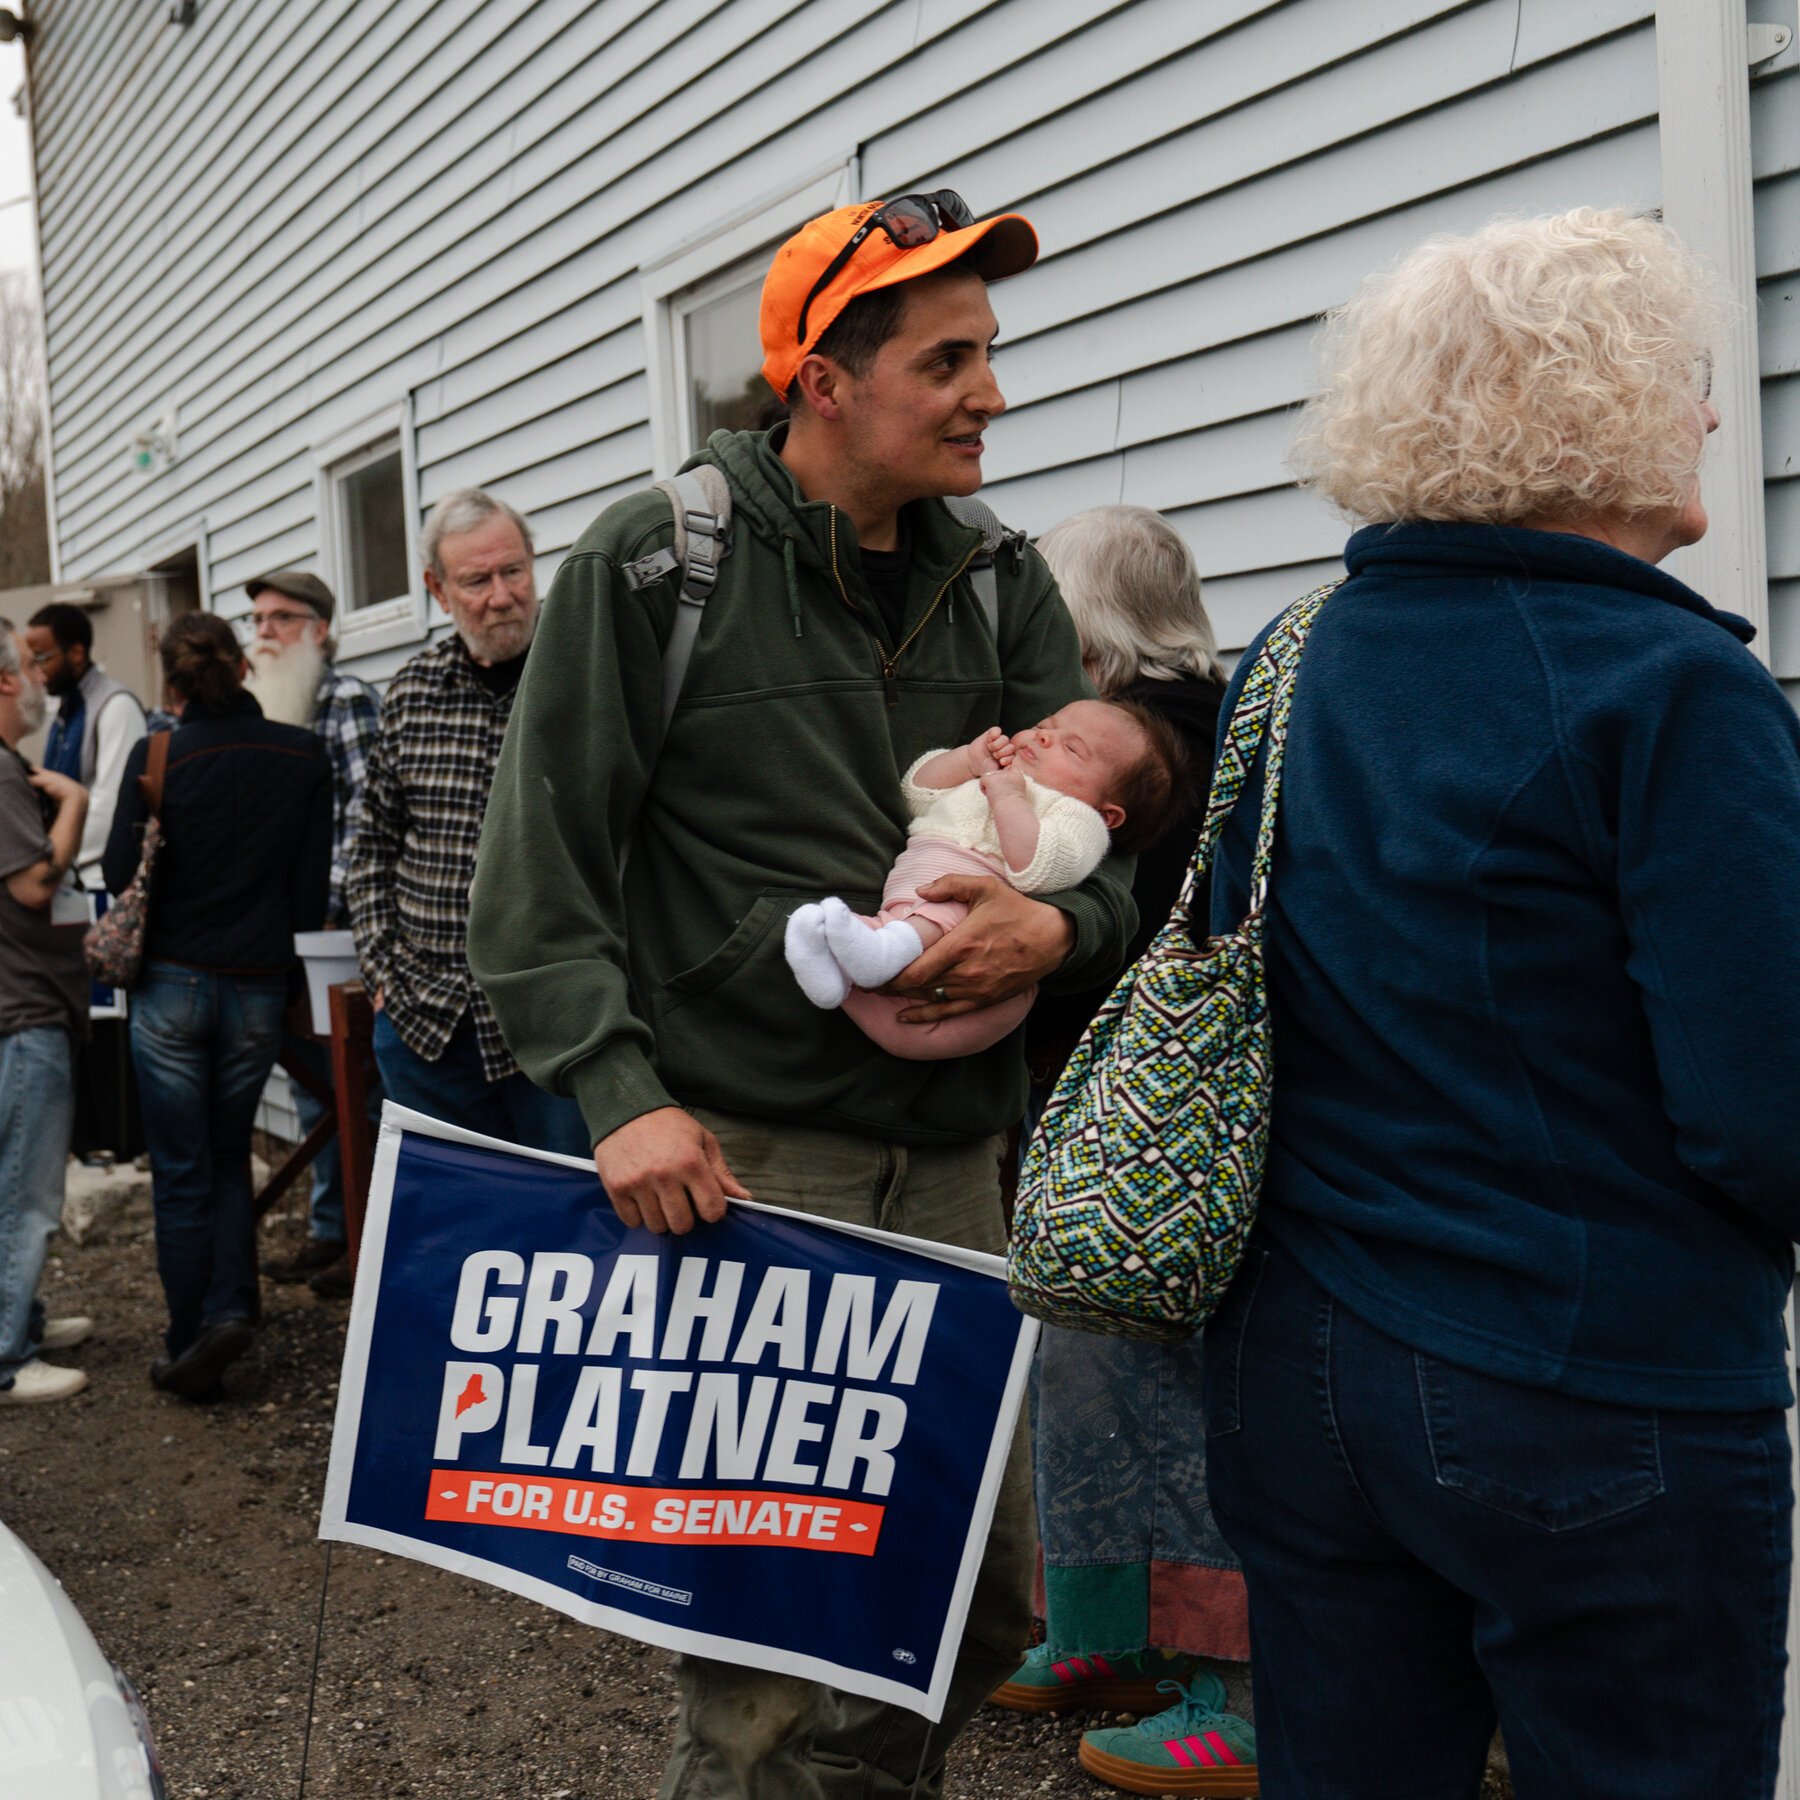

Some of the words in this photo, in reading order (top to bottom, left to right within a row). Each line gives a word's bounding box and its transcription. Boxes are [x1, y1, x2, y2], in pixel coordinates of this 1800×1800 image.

[450, 1250, 941, 1386] GRAHAM
[433, 1361, 907, 1497] PLATNER
[465, 1481, 552, 1519] FOR
[562, 1488, 636, 1531] U.S.
[651, 1498, 842, 1541] SENATE
[570, 1558, 586, 1570] PAID
[584, 1564, 598, 1576] FOR
[596, 1570, 609, 1579] BY
[608, 1573, 645, 1590] GRAHAM
[643, 1583, 662, 1596] FOR
[660, 1588, 689, 1602] MAINE
